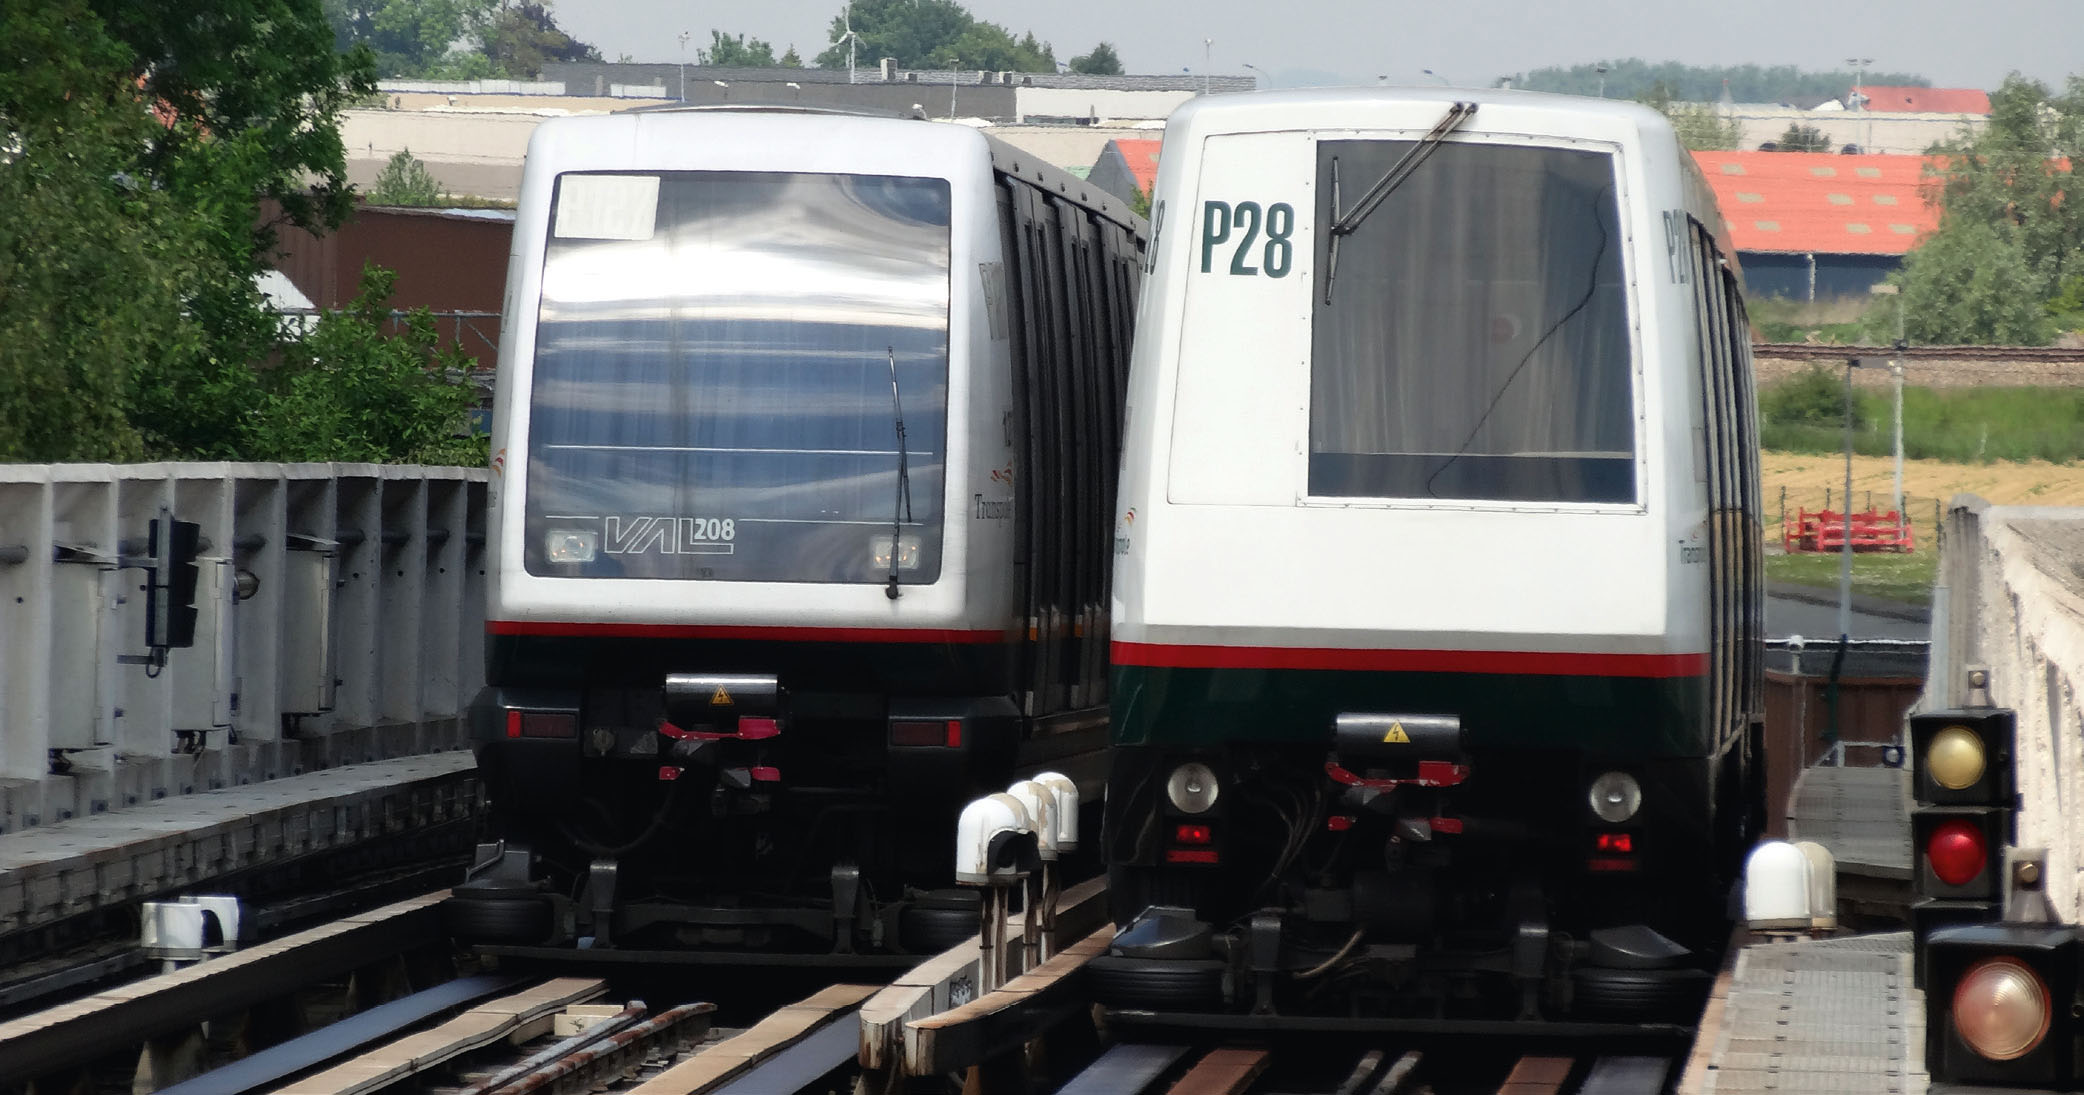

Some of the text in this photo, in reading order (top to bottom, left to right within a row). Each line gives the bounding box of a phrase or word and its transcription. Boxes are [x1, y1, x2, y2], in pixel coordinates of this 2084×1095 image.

[1201, 200, 1295, 279] P28
[604, 515, 736, 555] VAL 208
